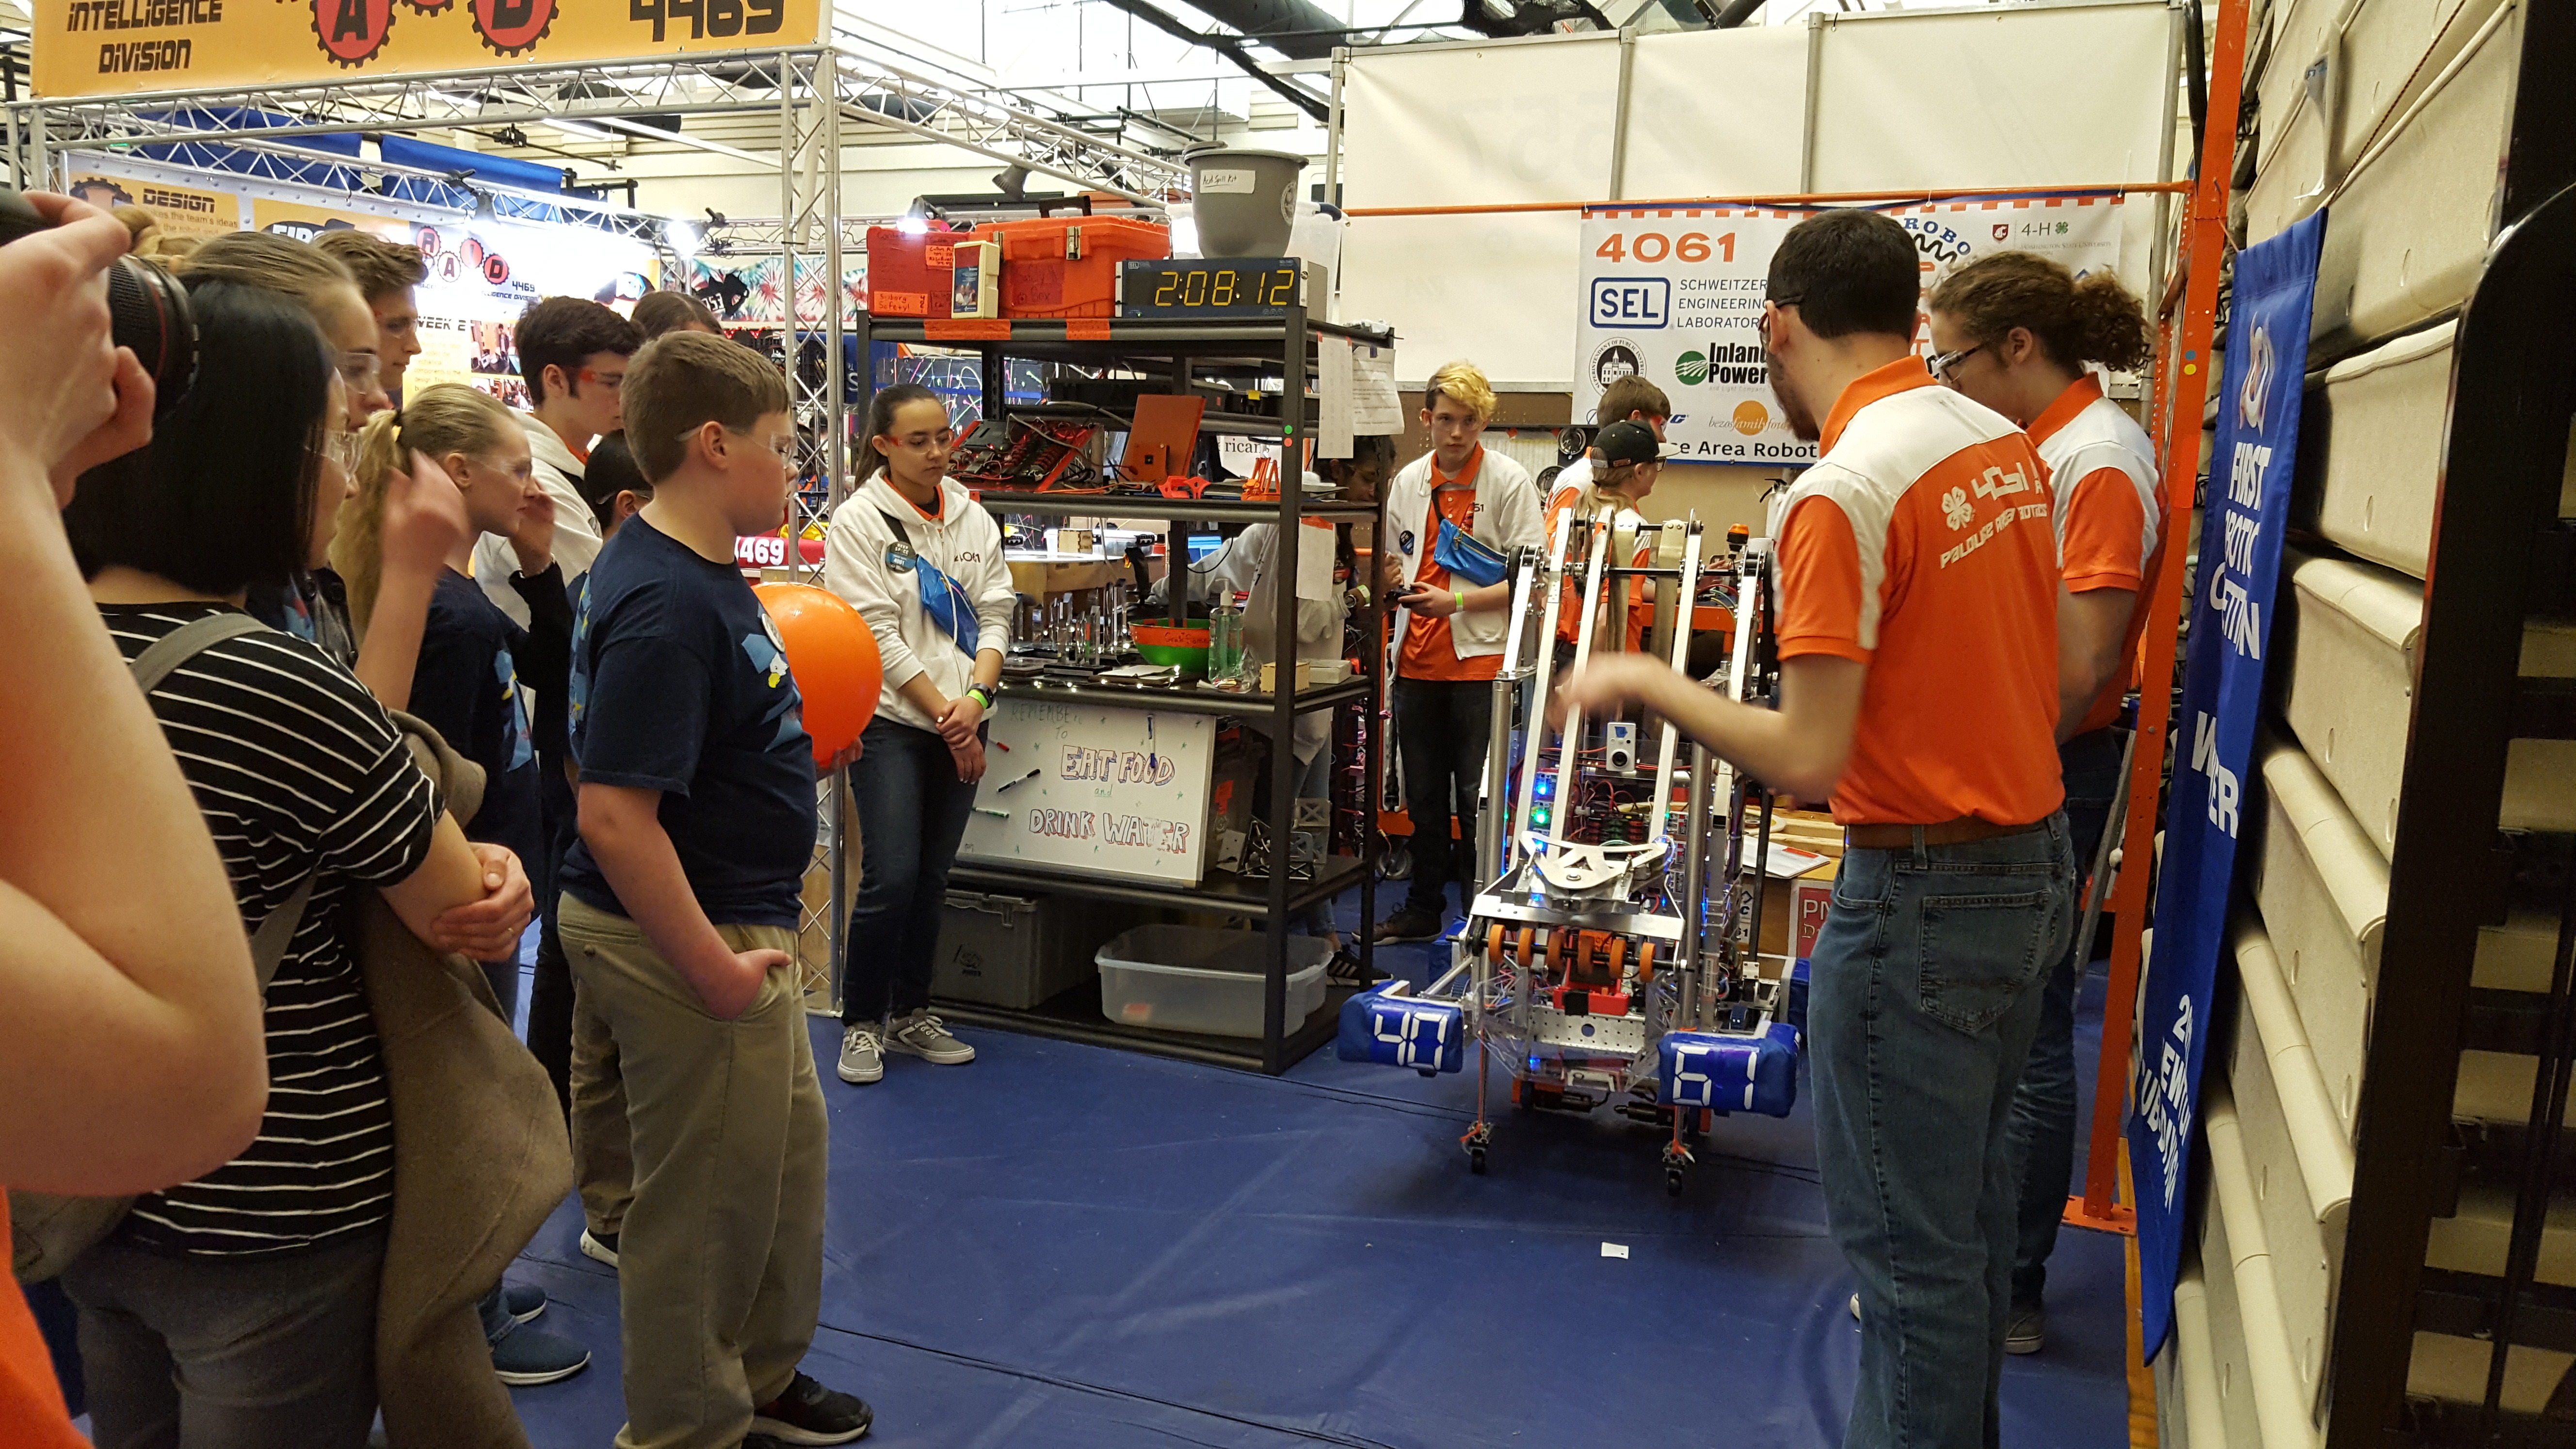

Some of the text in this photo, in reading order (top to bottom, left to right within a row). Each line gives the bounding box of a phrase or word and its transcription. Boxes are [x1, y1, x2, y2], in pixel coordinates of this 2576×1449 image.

[98, 39, 191, 74] DIVISION
[143, 188, 215, 213] DESIGN
[2021, 223, 2050, 236] 4-H
[1596, 232, 1736, 263] 4061
[512, 280, 535, 292] 4469
[1680, 279, 1768, 290] SCHWEITZER
[1600, 288, 1659, 318] SEL
[1677, 317, 1760, 328] LABORATOR
[1708, 363, 1769, 384] Power
[1697, 441, 1745, 456] Area
[1754, 443, 1818, 458] Robot
[2228, 441, 2272, 511] FIRST
[1061, 744, 1175, 786] EAT FOOD
[1094, 784, 1113, 796] and
[1029, 808, 1096, 839] DRINK
